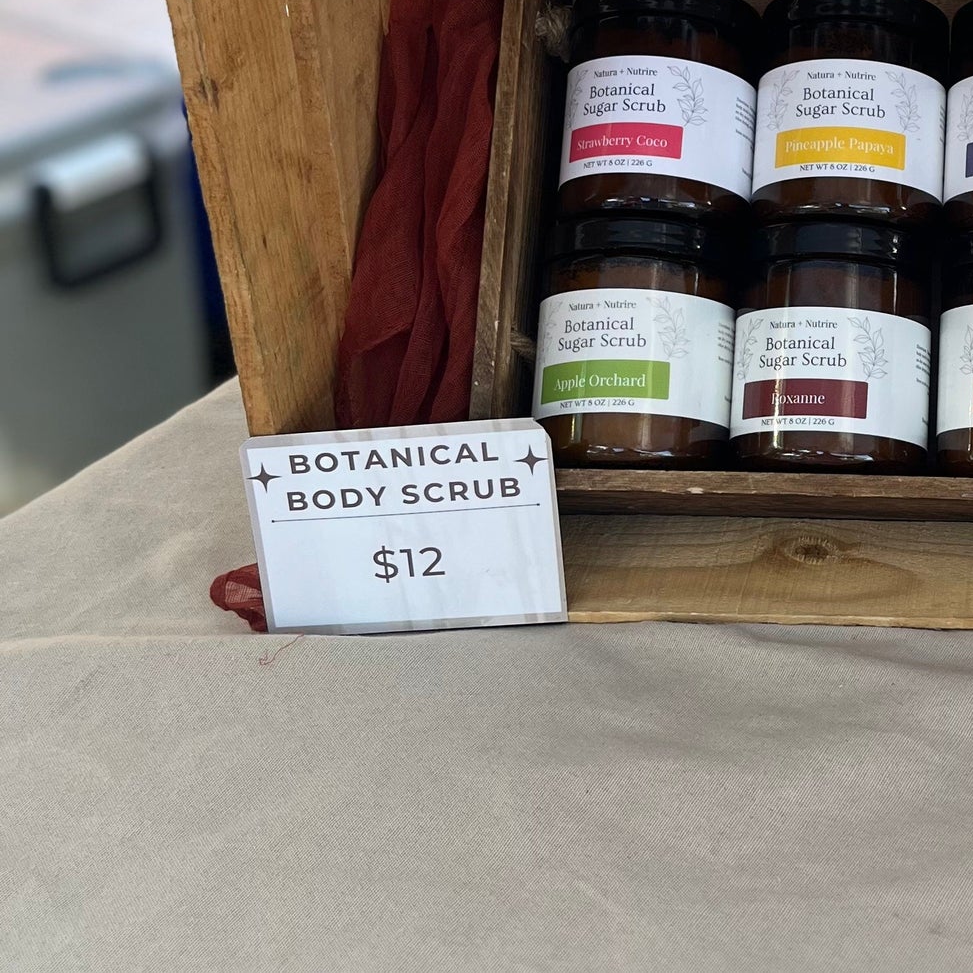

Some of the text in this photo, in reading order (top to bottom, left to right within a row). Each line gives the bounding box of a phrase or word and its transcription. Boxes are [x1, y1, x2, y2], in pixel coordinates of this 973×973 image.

[594, 68, 617, 79] Natura
[626, 67, 658, 77] Nutrire
[807, 71, 835, 81] Natura
[845, 71, 876, 81] Nutrire
[589, 83, 655, 100] Botanical
[803, 87, 874, 101] Botanical
[583, 98, 666, 117] Sugar Scrub
[795, 103, 886, 118] Sugar Scrub
[577, 135, 668, 151] Strawberry Coco
[785, 136, 894, 155] Pineapple Papaya
[569, 302, 594, 312] Natura
[604, 300, 637, 309] Nutrire
[564, 317, 634, 334] Botanical
[769, 320, 796, 329] Natura
[805, 319, 838, 329] Nutrire
[558, 333, 647, 353] Sugar Scrub
[765, 336, 835, 351] Botanical
[759, 353, 847, 371] Sugar Scrub
[554, 373, 646, 392] Apple Orchard
[560, 401, 573, 409] NET
[574, 400, 587, 408] WT
[761, 418, 774, 426] NET
[289, 441, 499, 474] BOTANICAL
[286, 477, 521, 512] BODY SCRUB
[372, 545, 446, 584] $12
